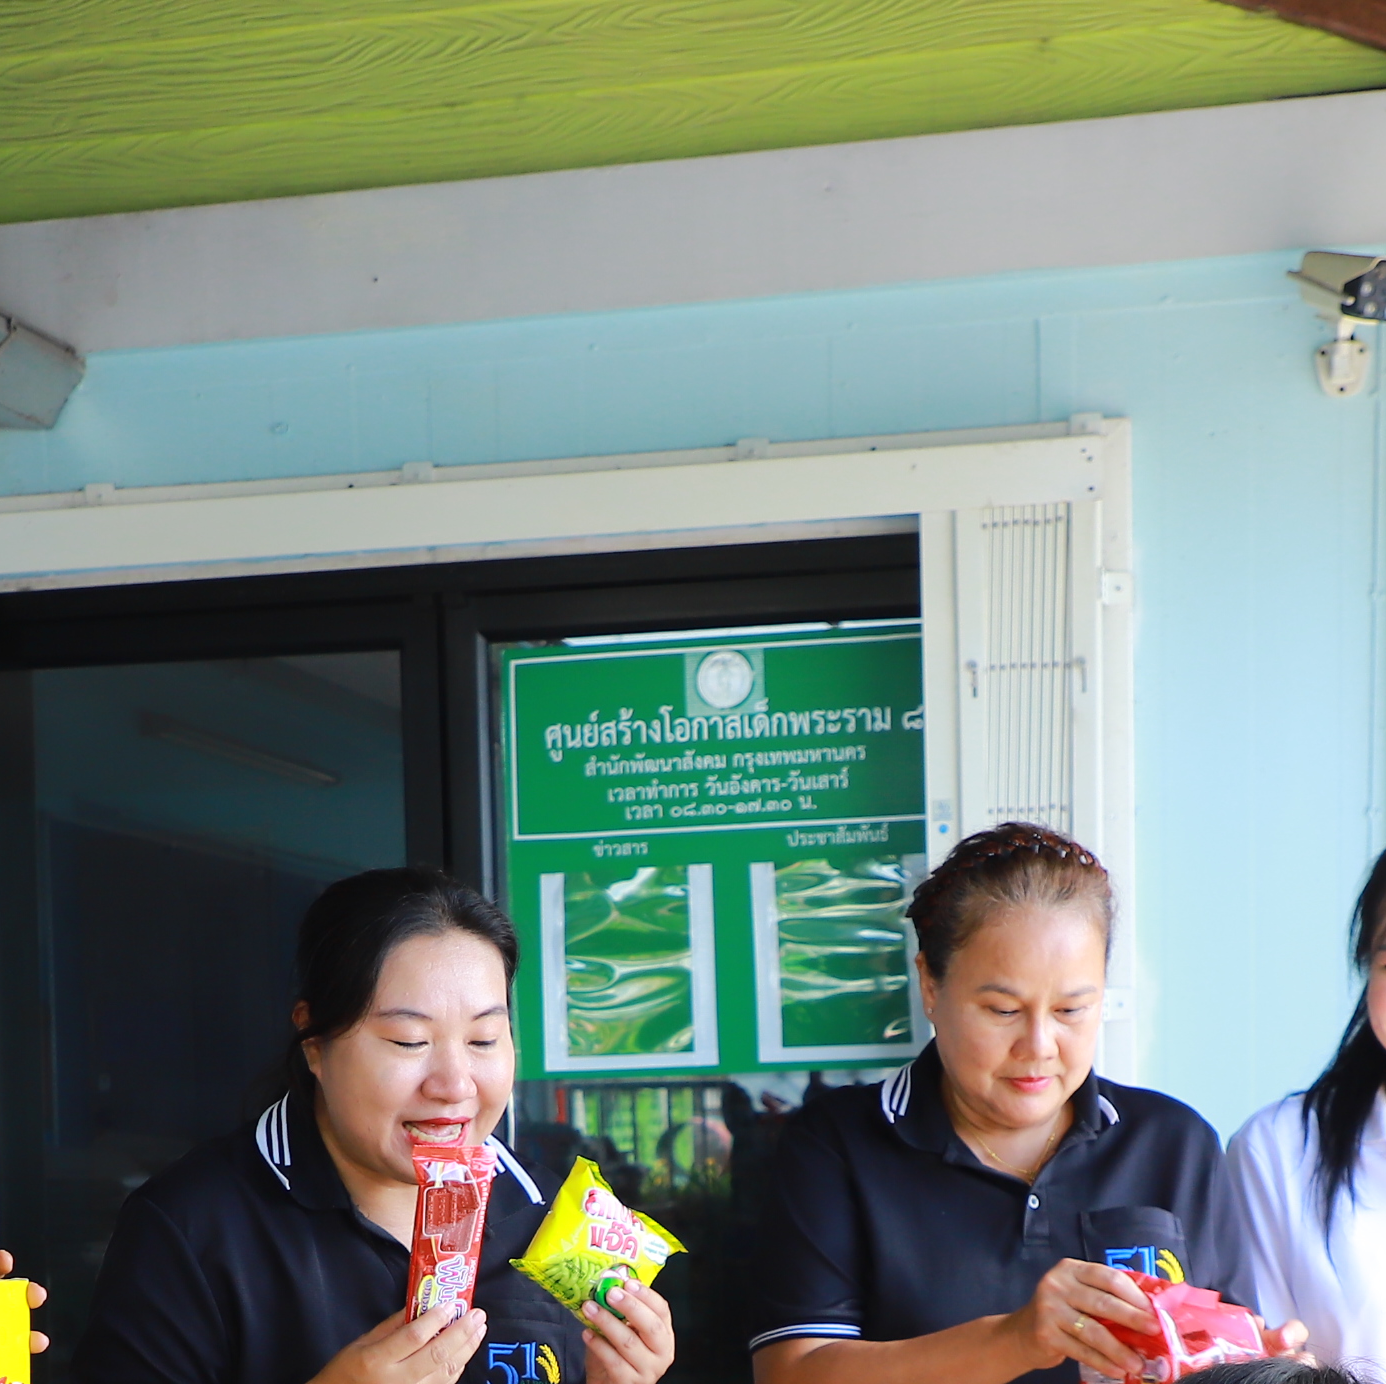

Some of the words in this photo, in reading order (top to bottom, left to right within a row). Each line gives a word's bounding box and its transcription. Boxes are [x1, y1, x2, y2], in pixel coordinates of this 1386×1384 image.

[544, 699, 892, 762] ศูนย์สร้างโอกาสเด็กพระราม
[584, 748, 727, 778] สำนักพัฒนาสังคม
[732, 744, 867, 774] กรุงเทพมหานคร
[607, 777, 699, 802] เวลาทำการ
[704, 766, 850, 798] วันอังคาร-วันเสาร์
[625, 803, 663, 821] เวลา
[799, 794, 817, 812] น.
[592, 838, 649, 857] ข่าวสาร
[590, 1221, 638, 1259] แจ๊ค
